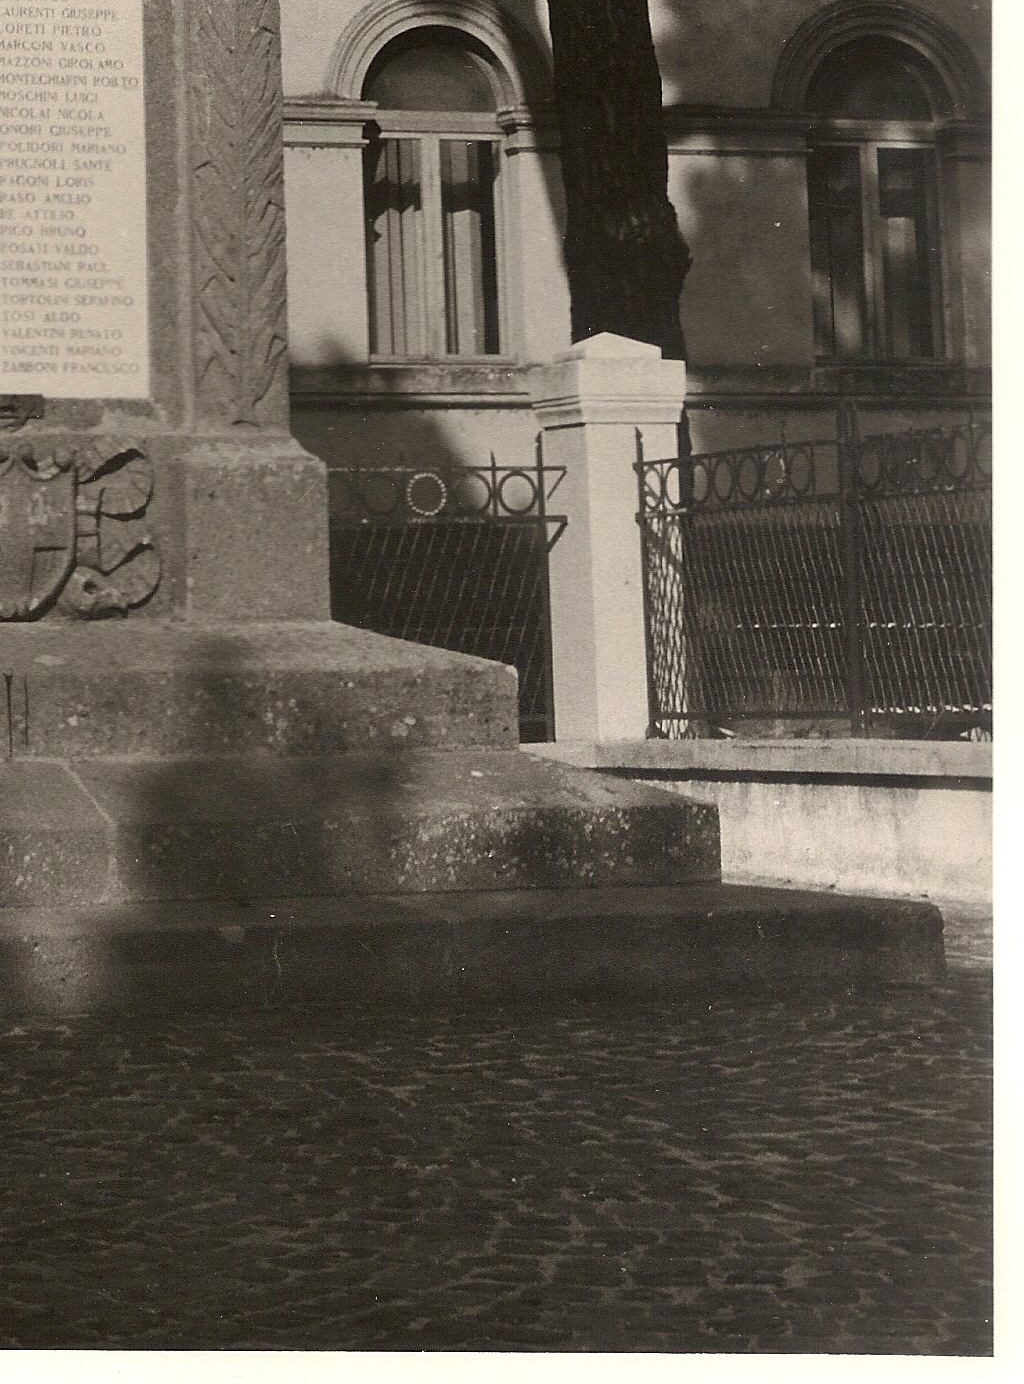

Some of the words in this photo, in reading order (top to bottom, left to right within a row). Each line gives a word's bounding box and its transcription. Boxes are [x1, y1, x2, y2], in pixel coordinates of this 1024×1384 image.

[62, 8, 118, 20] GIUSEPPE
[53, 25, 102, 36] PIETRO
[61, 41, 105, 53] VASCO
[58, 58, 124, 70] GIROLAMO
[66, 91, 98, 103] LUIGI
[58, 108, 104, 120] NICOLA
[50, 125, 112, 137] GIUSEPPE
[0, 141, 63, 152] POLIDORI
[71, 142, 126, 155] MARIANO
[0, 158, 65, 170] PRUGNOLI
[74, 160, 113, 172] SANTE
[56, 176, 94, 187] LORIS
[45, 193, 92, 205] AMELIO
[24, 210, 74, 220] ATTILIO
[41, 226, 86, 238] BRUNO
[55, 244, 99, 255] VALDO
[1, 260, 71, 271] SEBASTIANI
[2, 277, 58, 288] TOMMASI
[64, 277, 123, 290] GIUSEPPE
[75, 295, 134, 306] SERAFINO
[2, 310, 35, 322] TOSI
[44, 311, 81, 323] ALDO
[2, 328, 64, 338] VALENTINI
[70, 329, 122, 340] RENATO
[66, 346, 122, 356] MARIANO
[63, 362, 140, 374] FRANCESCO
